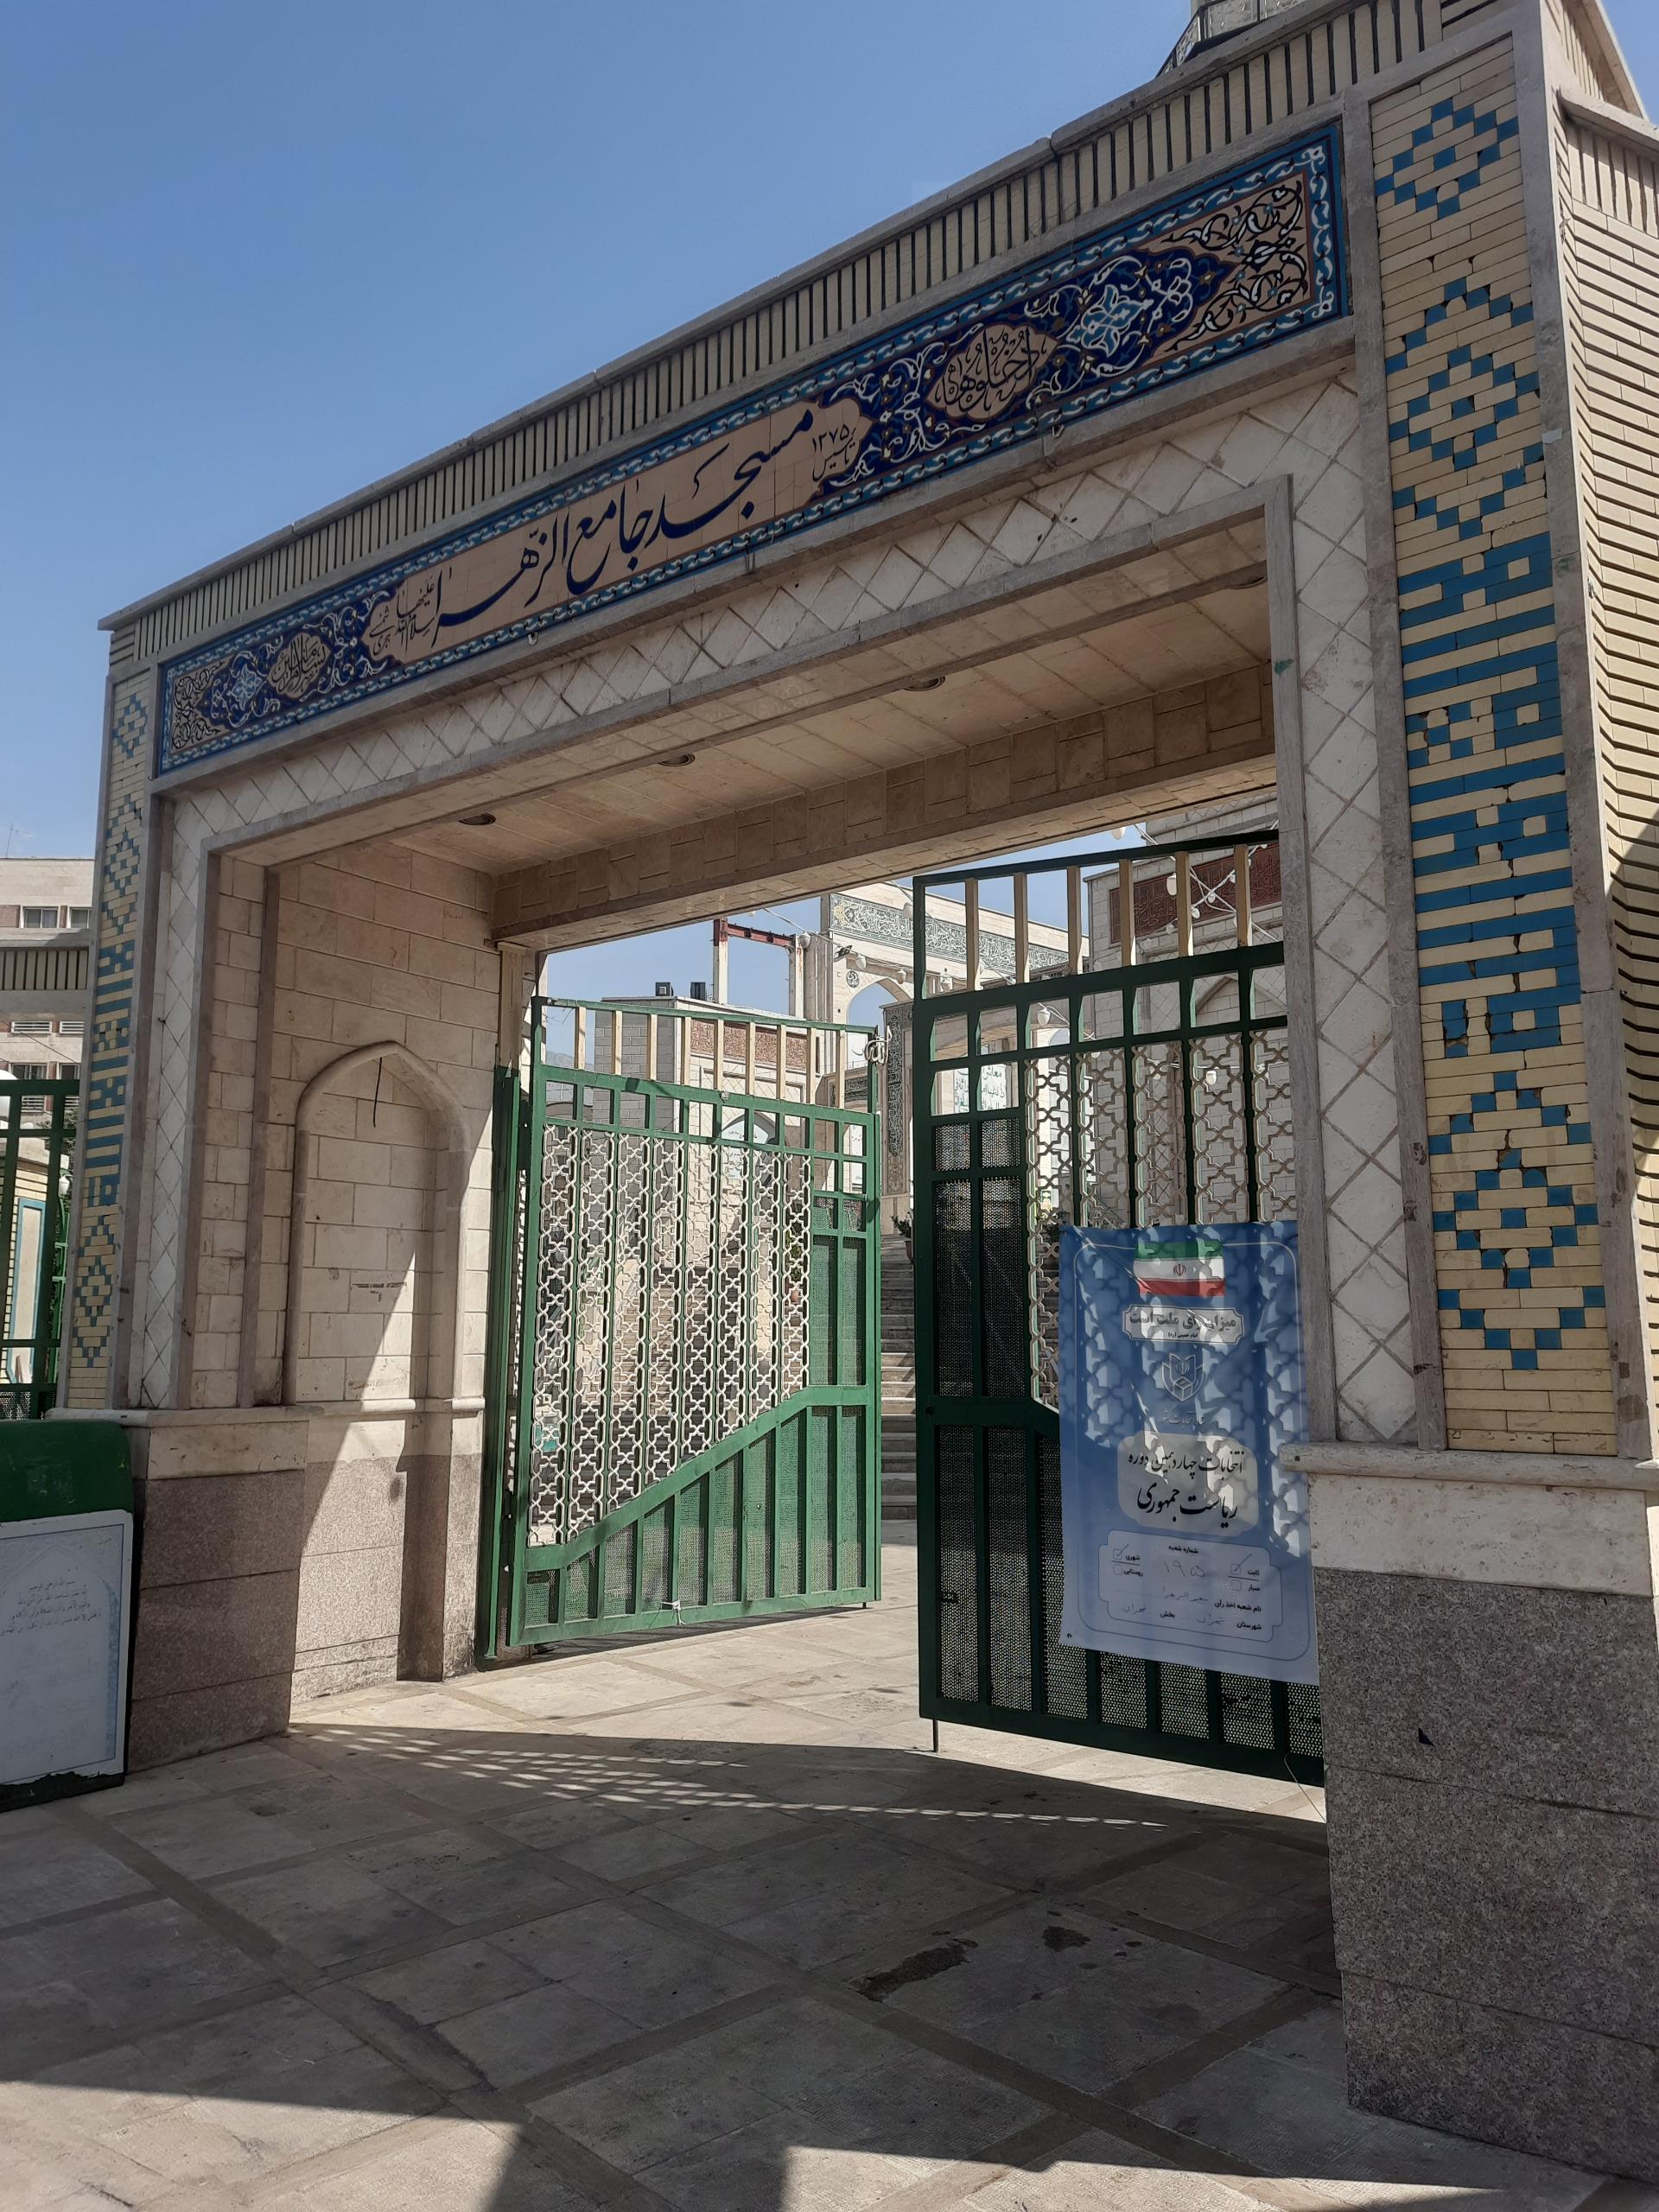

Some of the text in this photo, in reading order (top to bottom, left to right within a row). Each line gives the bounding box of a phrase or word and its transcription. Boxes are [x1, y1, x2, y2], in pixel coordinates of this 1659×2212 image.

[645, 408, 814, 550] مسجد
[566, 482, 654, 596] جامع
[864, 1025, 893, 1068] الله
[1130, 1311, 1154, 1324] است
[1157, 1313, 1179, 1325] ملت
[1128, 1451, 1245, 1481] انتخابات چهاردهمین دوره
[1137, 1482, 1238, 1529] ریاست جمهوری
[1160, 1610, 1176, 1618] بخش
[1253, 1605, 1262, 1613] نام
[1236, 1621, 1262, 1631] شهرستان
